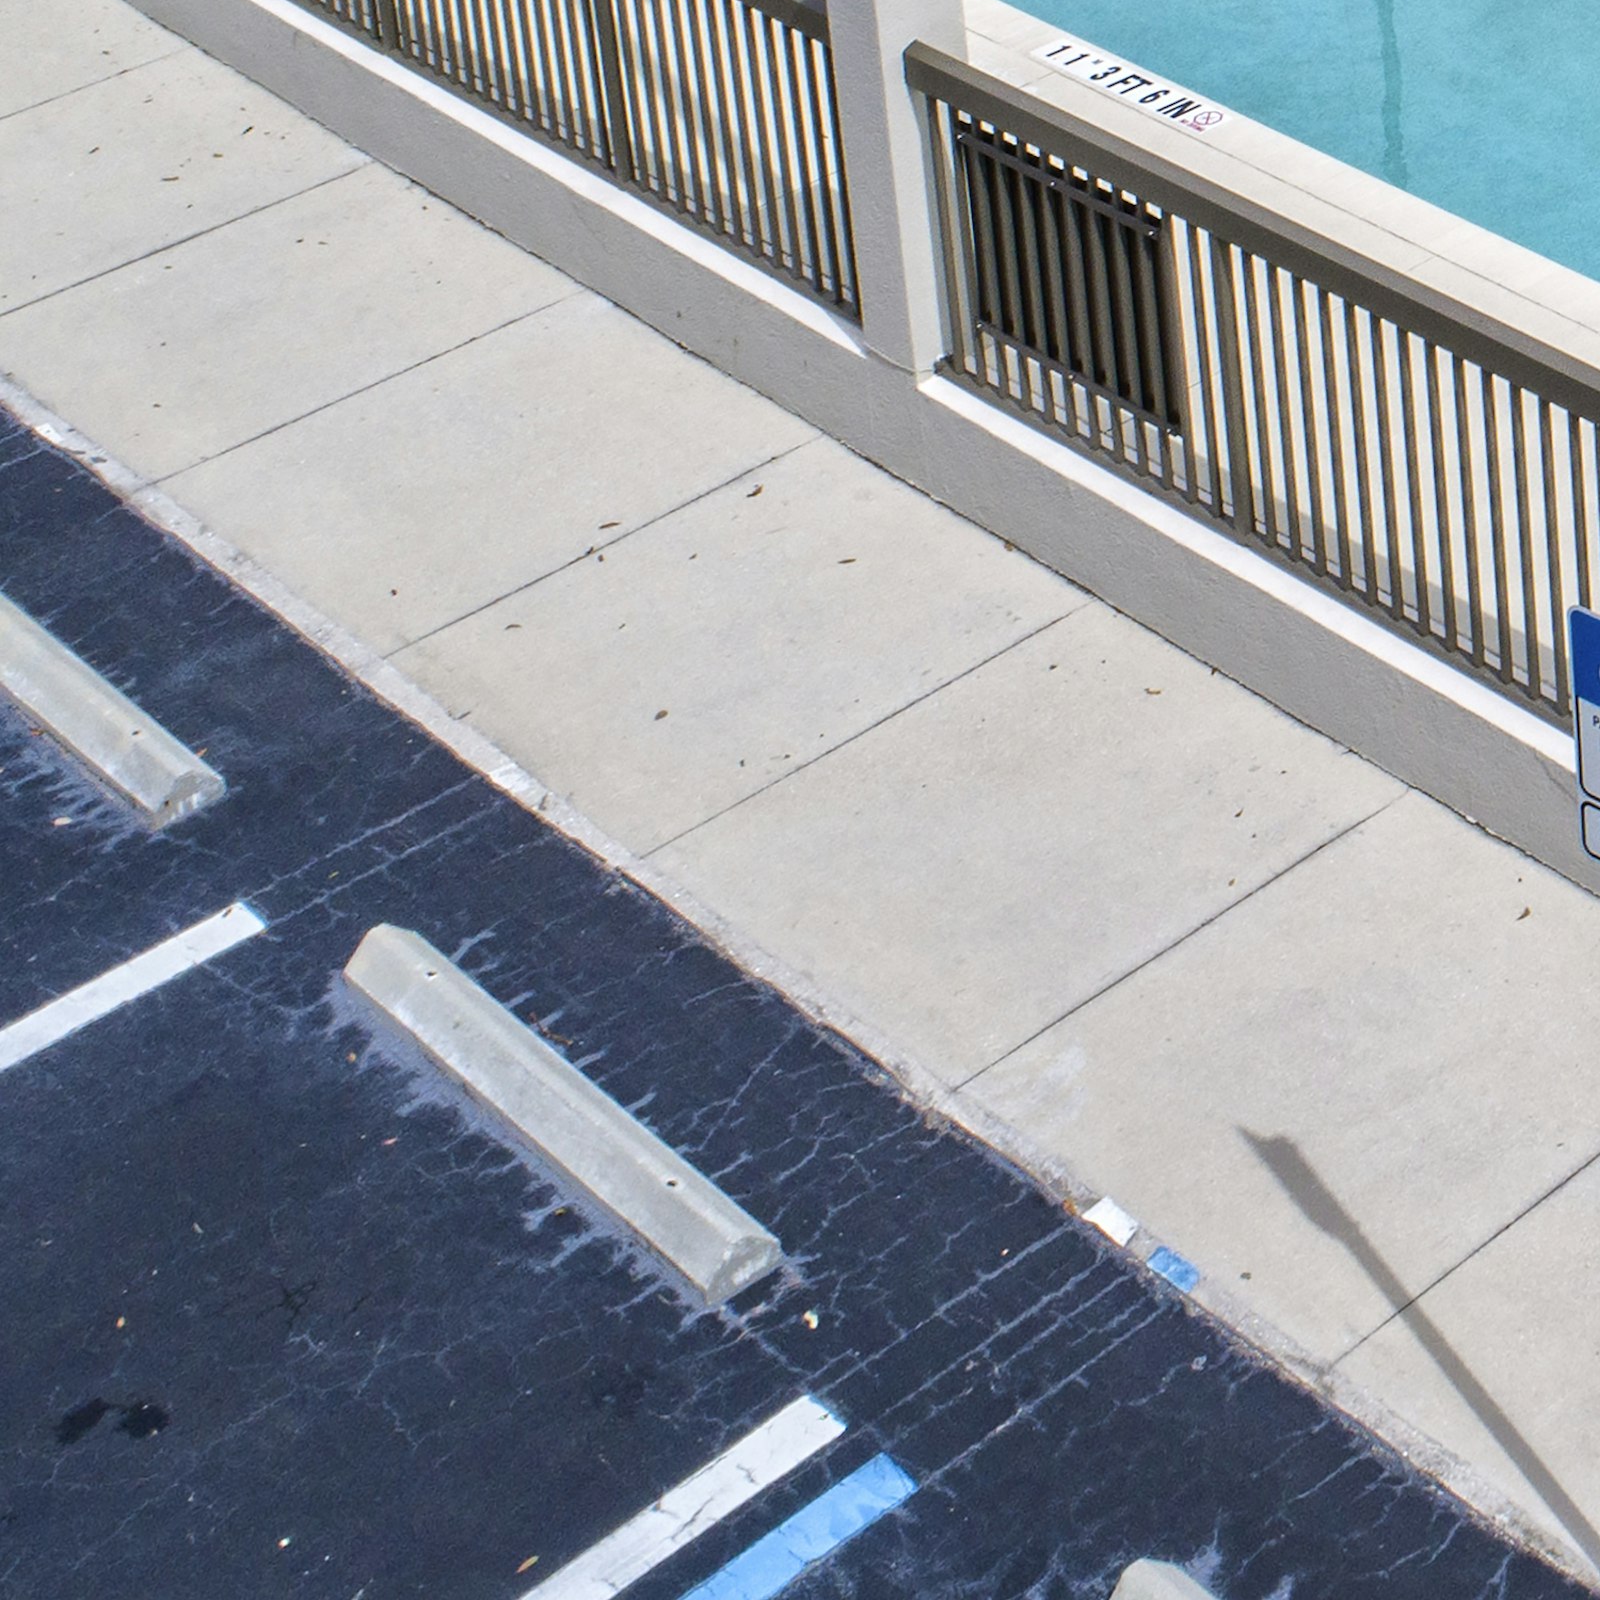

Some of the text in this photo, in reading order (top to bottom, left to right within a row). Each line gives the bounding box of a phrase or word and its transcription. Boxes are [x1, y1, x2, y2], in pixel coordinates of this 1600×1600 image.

[1090, 65, 1122, 82] 3
[1106, 74, 1153, 95] FT
[1138, 89, 1170, 105] 6
[1156, 97, 1202, 119] IN
